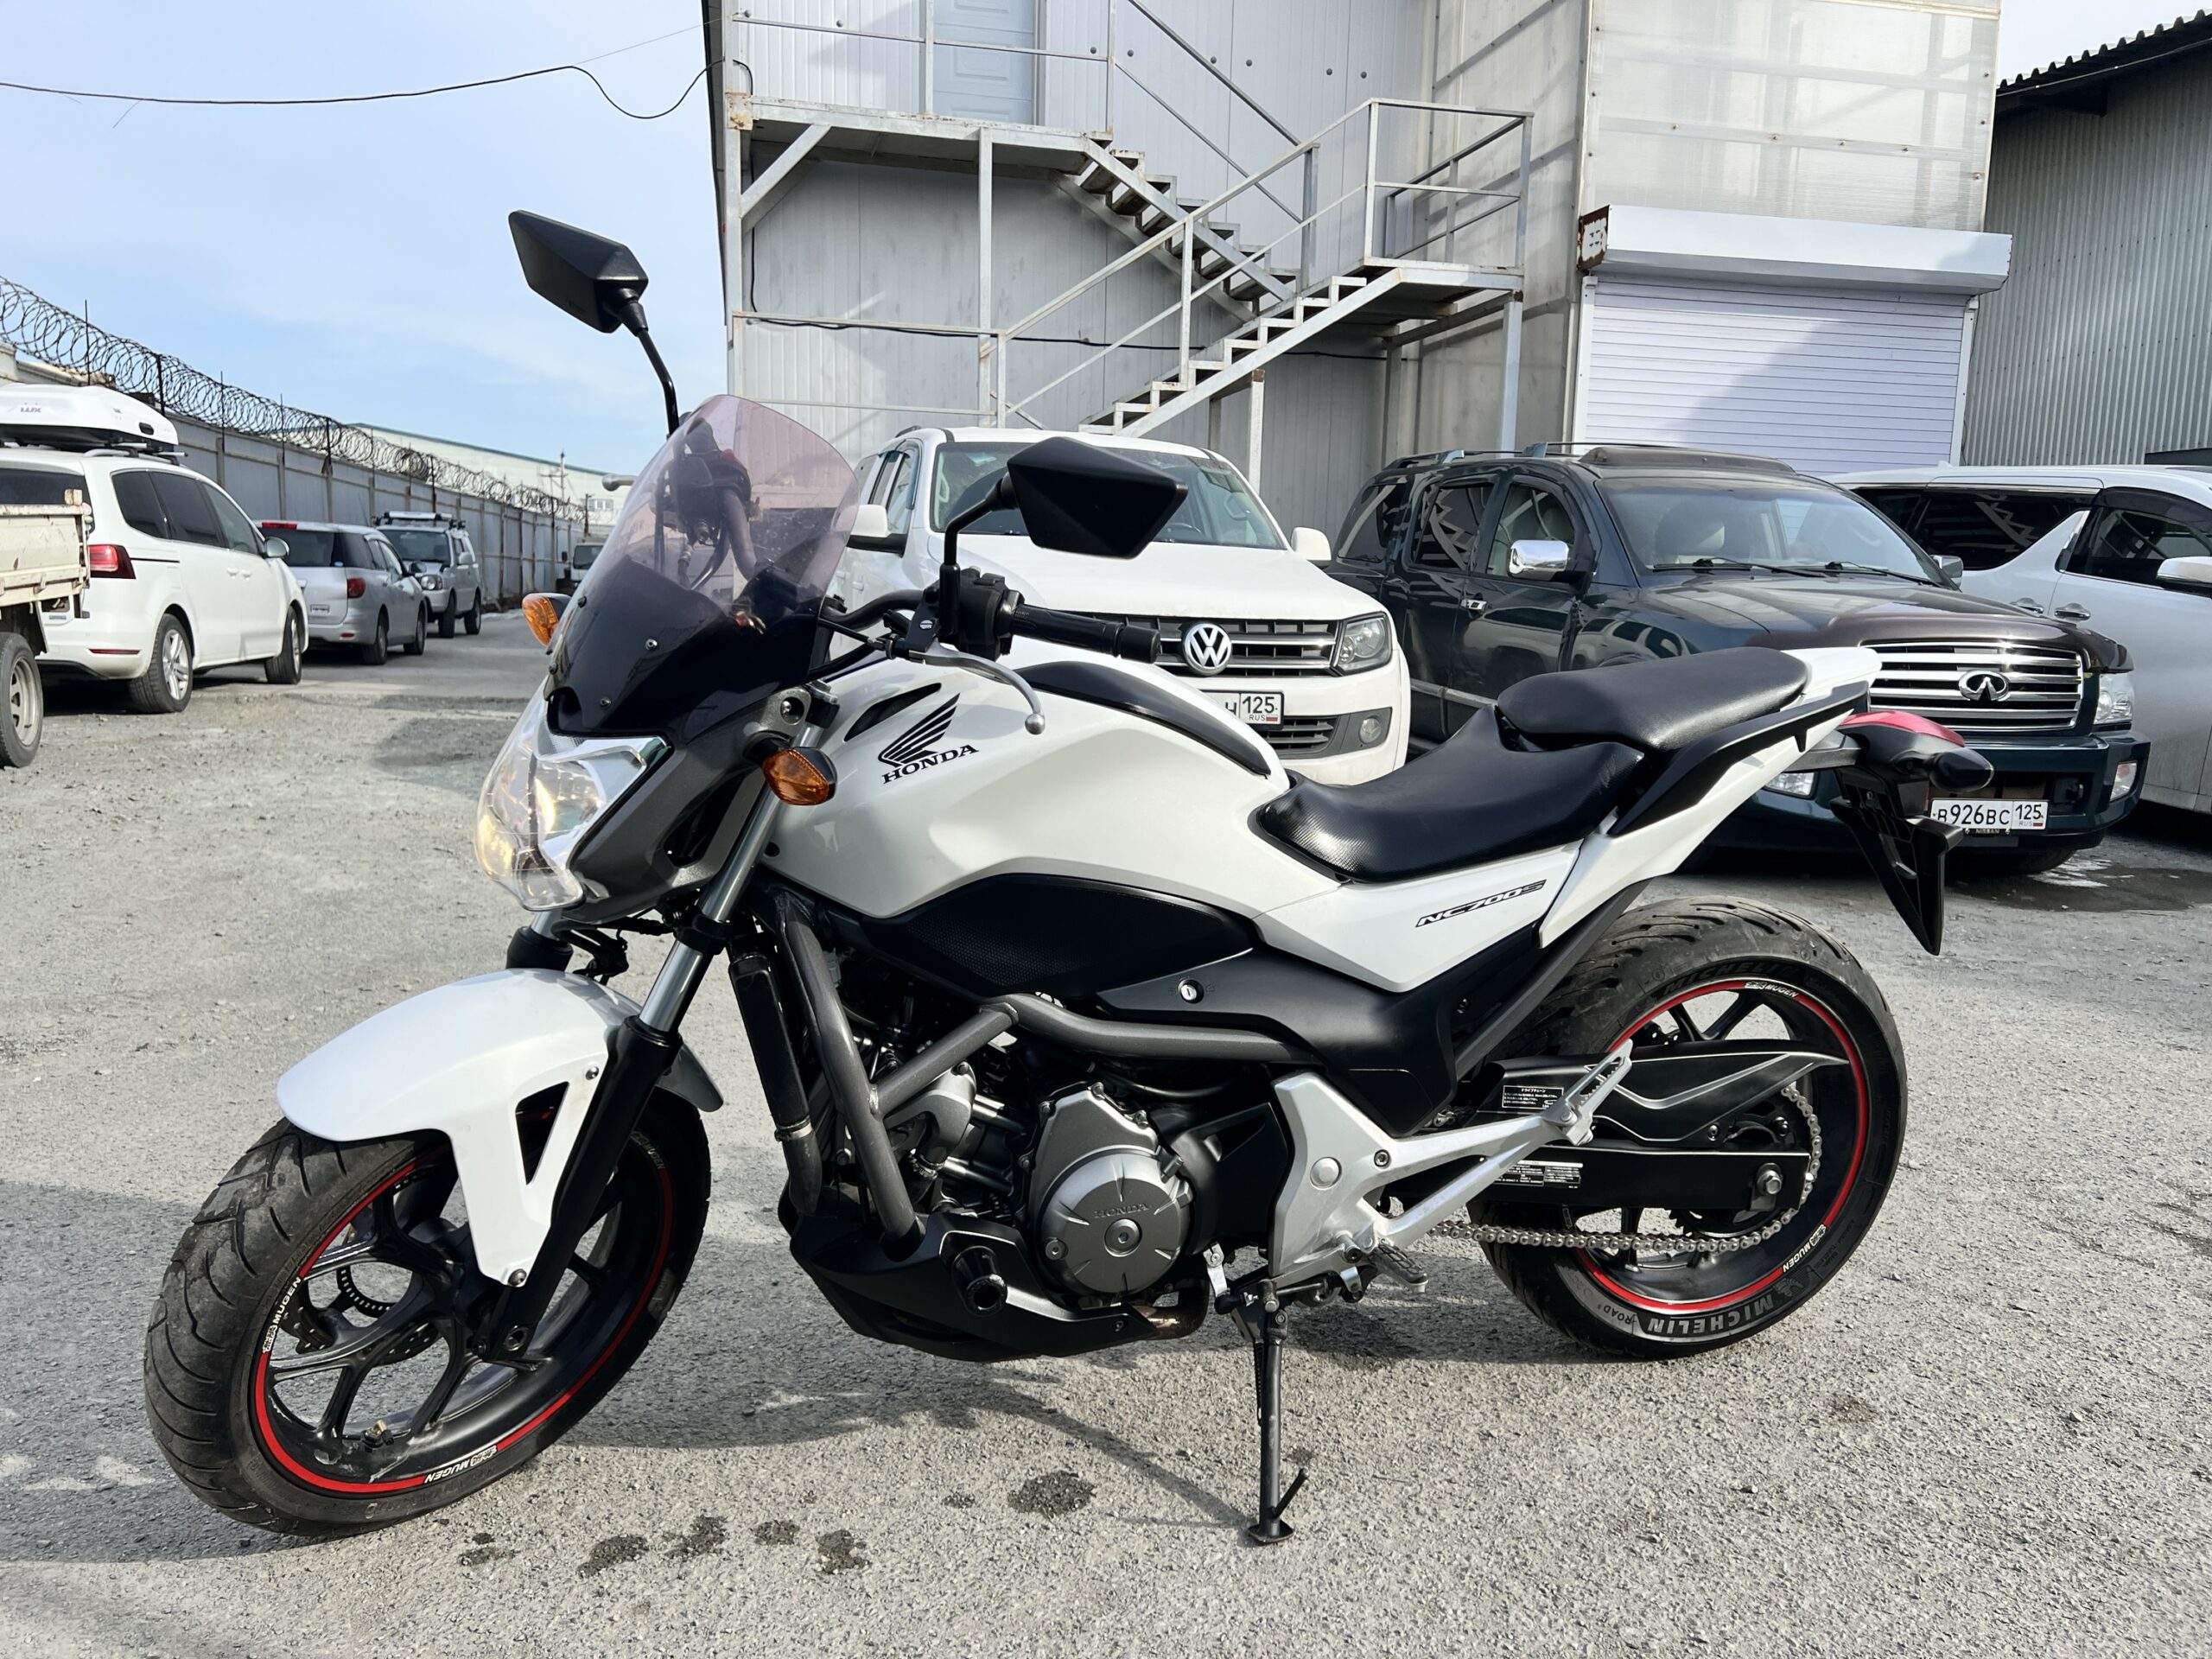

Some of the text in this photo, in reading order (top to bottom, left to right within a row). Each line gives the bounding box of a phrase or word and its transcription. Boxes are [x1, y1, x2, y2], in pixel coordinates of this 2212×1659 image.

[1242, 696, 1274, 714] 125
[881, 744, 979, 785] HONDA
[2015, 804, 2043, 820] 125
[1415, 879, 1547, 928] NC700S
[1764, 983, 1799, 999] MUGEN
[642, 1141, 666, 1170] MUGEN
[1094, 1203, 1149, 1219] HONDA
[1783, 1242, 1811, 1273] MUGEN
[274, 1276, 302, 1327] MUGEN
[1603, 1305, 1633, 1325] ROAD
[1647, 1293, 1775, 1335] MICHELIN
[424, 1459, 470, 1484] MUGEN
